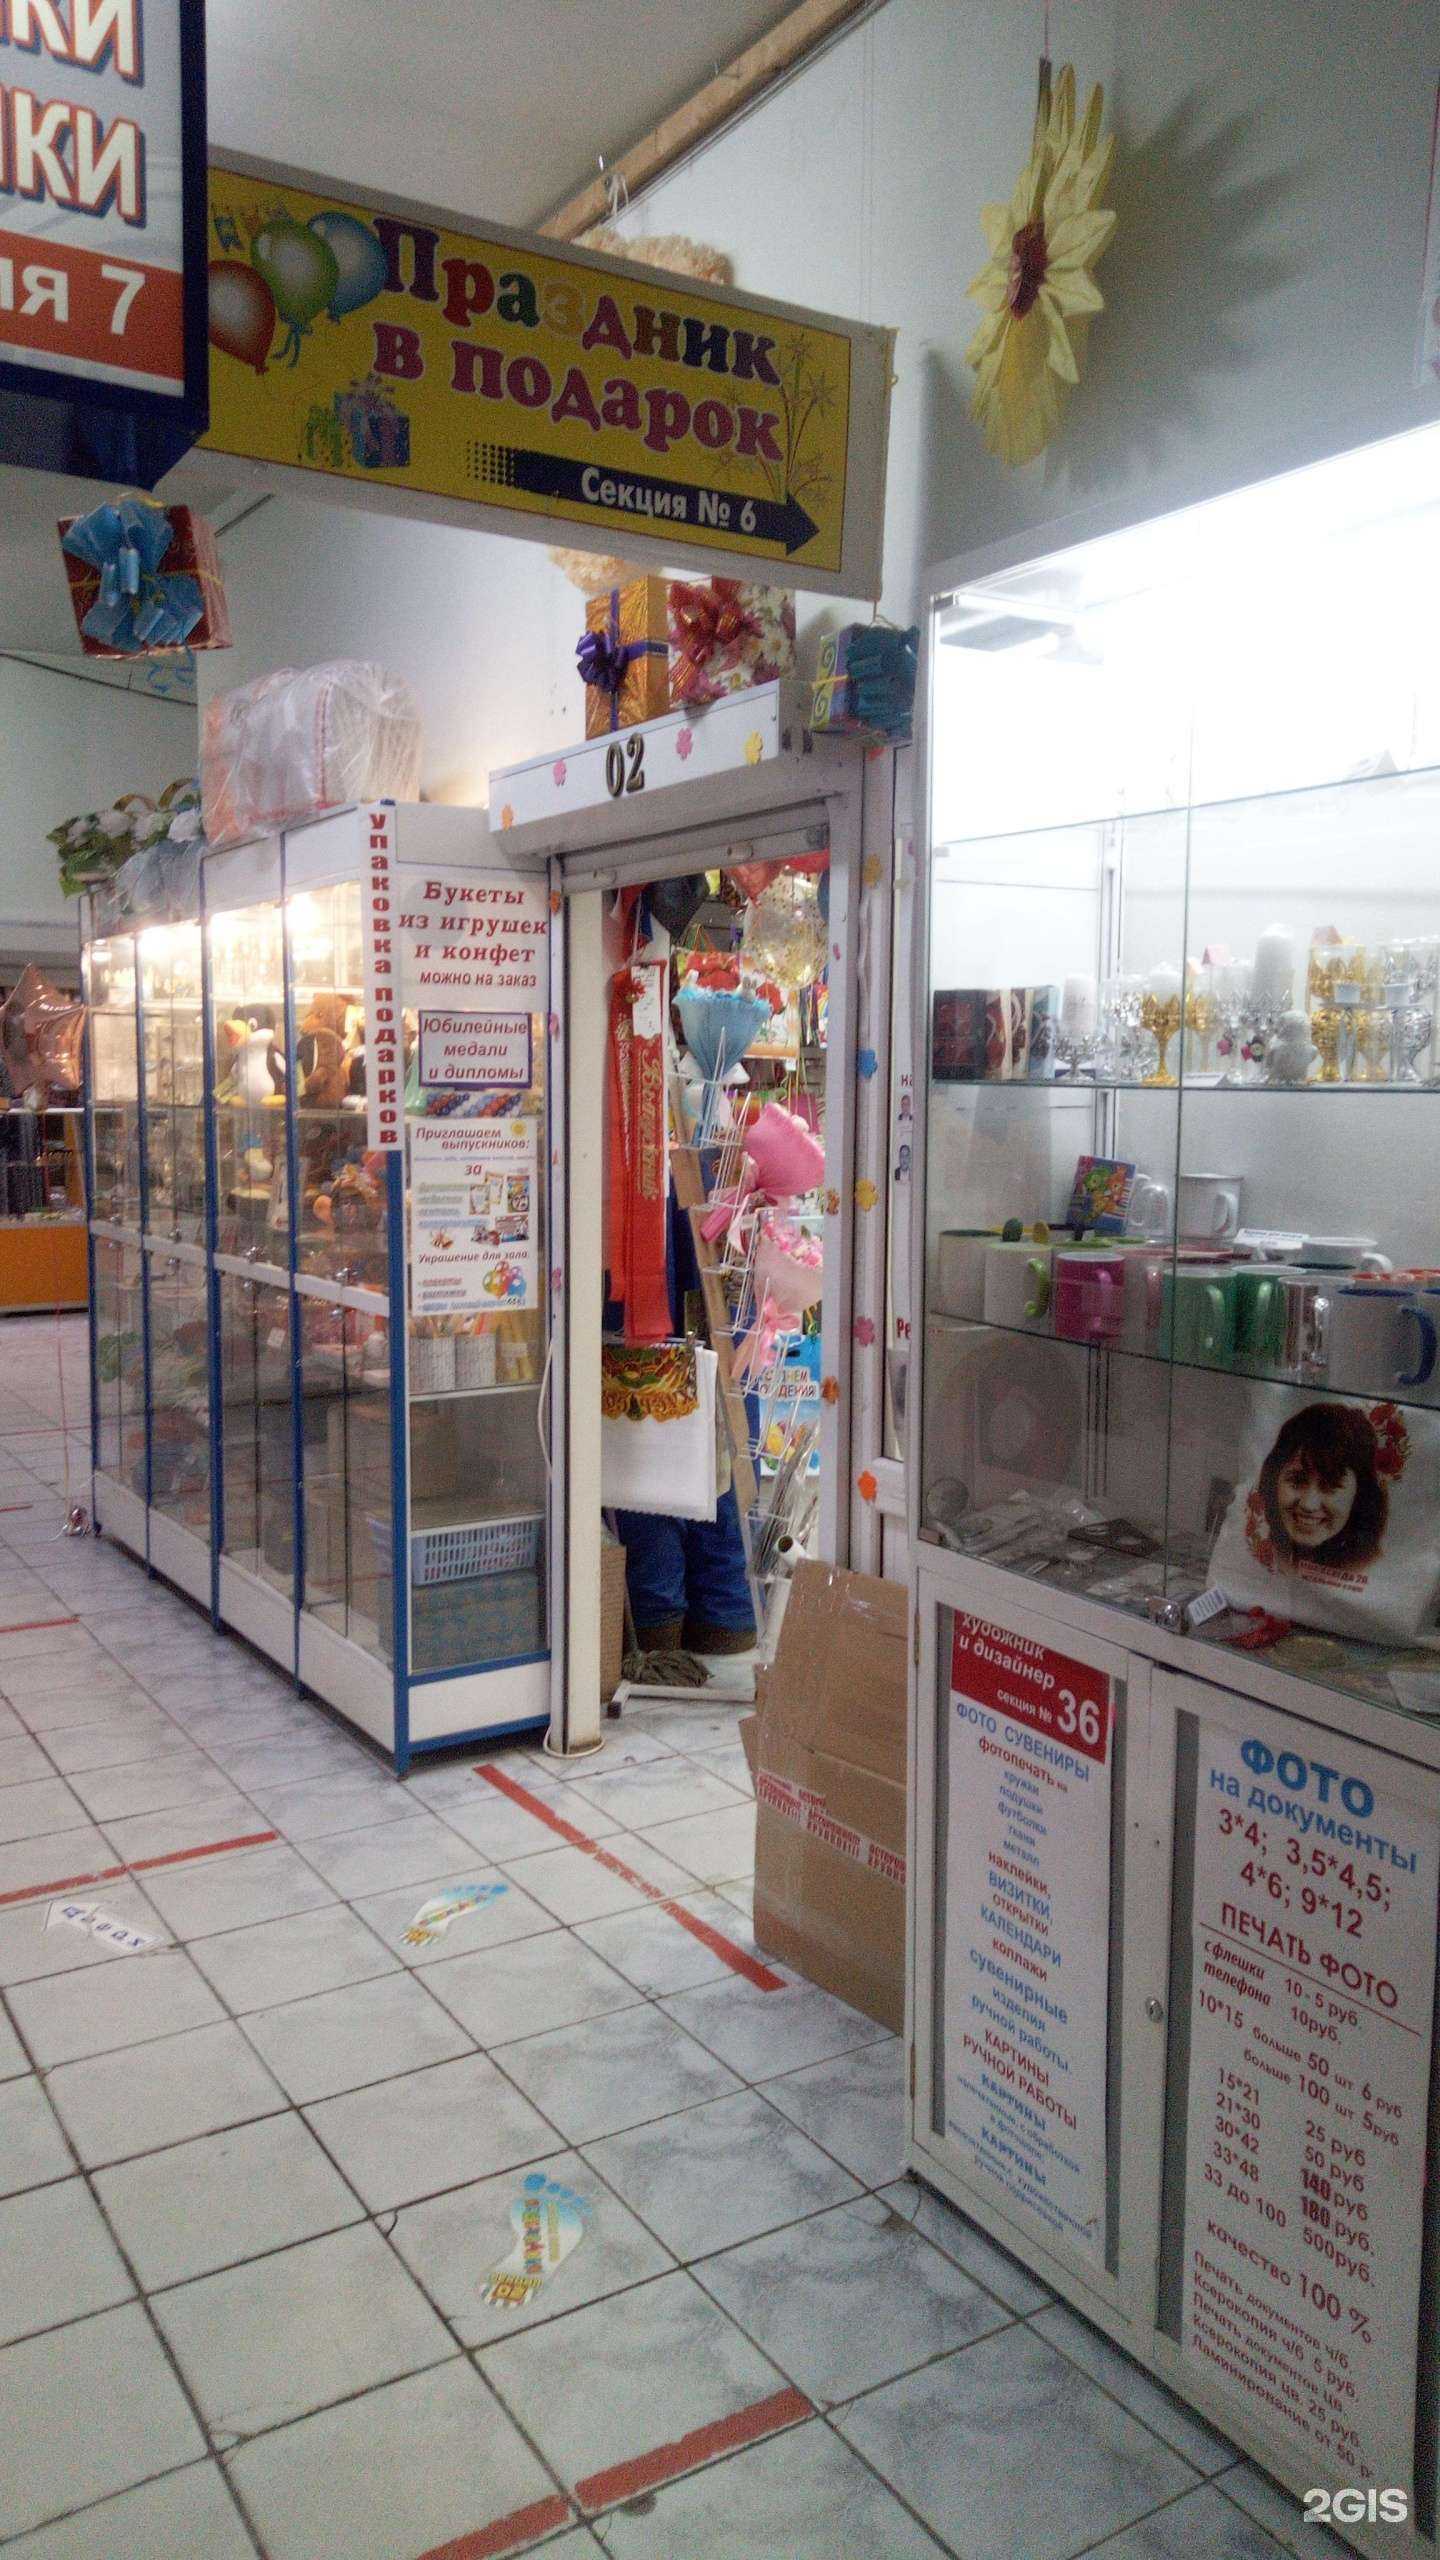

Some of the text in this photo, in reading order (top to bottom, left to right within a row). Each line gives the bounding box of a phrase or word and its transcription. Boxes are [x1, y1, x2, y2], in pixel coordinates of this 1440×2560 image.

[0, 84, 144, 226] КИ
[101, 264, 146, 336] 7
[373, 217, 782, 387] Праздник
[451, 340, 785, 464] подарок
[580, 466, 688, 520] Секция
[741, 502, 757, 534] 6
[606, 732, 645, 798] 02
[423, 881, 525, 904] Букеты
[399, 913, 548, 937] из игрушек
[414, 943, 536, 964] и конфет
[420, 971, 538, 988] можно на заказ
[423, 1017, 528, 1034] Юбилейные
[443, 1043, 508, 1057] медали
[428, 1065, 524, 1080] и дипломы
[416, 1126, 502, 1140] Приглашаем
[959, 1634, 1055, 1690] и дизайнер
[961, 1612, 1045, 1661] художник
[956, 1702, 1089, 1782] ФОТО СУВЕНИРЫ
[996, 1689, 1037, 1715] секция
[1057, 1688, 1100, 1746] 36
[978, 1735, 1055, 1786] фотопечать
[1240, 1738, 1375, 1818] ФОТО
[1210, 1769, 1417, 1873] на документы
[981, 1905, 1062, 1968] КАЛЕНДАРИ
[992, 1938, 1048, 1982] коллажи
[1222, 1902, 1398, 2009] ПЕЧАТЬ ФОТО
[970, 1949, 1068, 2025] сувенирные
[1204, 1960, 1271, 2007] телефона
[1285, 1977, 1302, 1998] 10
[1315, 1992, 1324, 2008] 5
[985, 2029, 1050, 2087] КАРТИНЫ
[1244, 2049, 1291, 2084] больше
[1299, 2074, 1330, 2106] 100
[1252, 2025, 1301, 2063] больше
[1307, 2052, 1329, 2076] 50
[1362, 2083, 1372, 2101] 6
[1019, 2075, 1077, 2130] РАБОТЫ
[1305, 2120, 1325, 2142] 25
[1305, 2145, 1325, 2168] 50
[1256, 2198, 1286, 2227] 100
[1208, 2219, 1291, 2286] качество
[1300, 2273, 1341, 2321] 100
